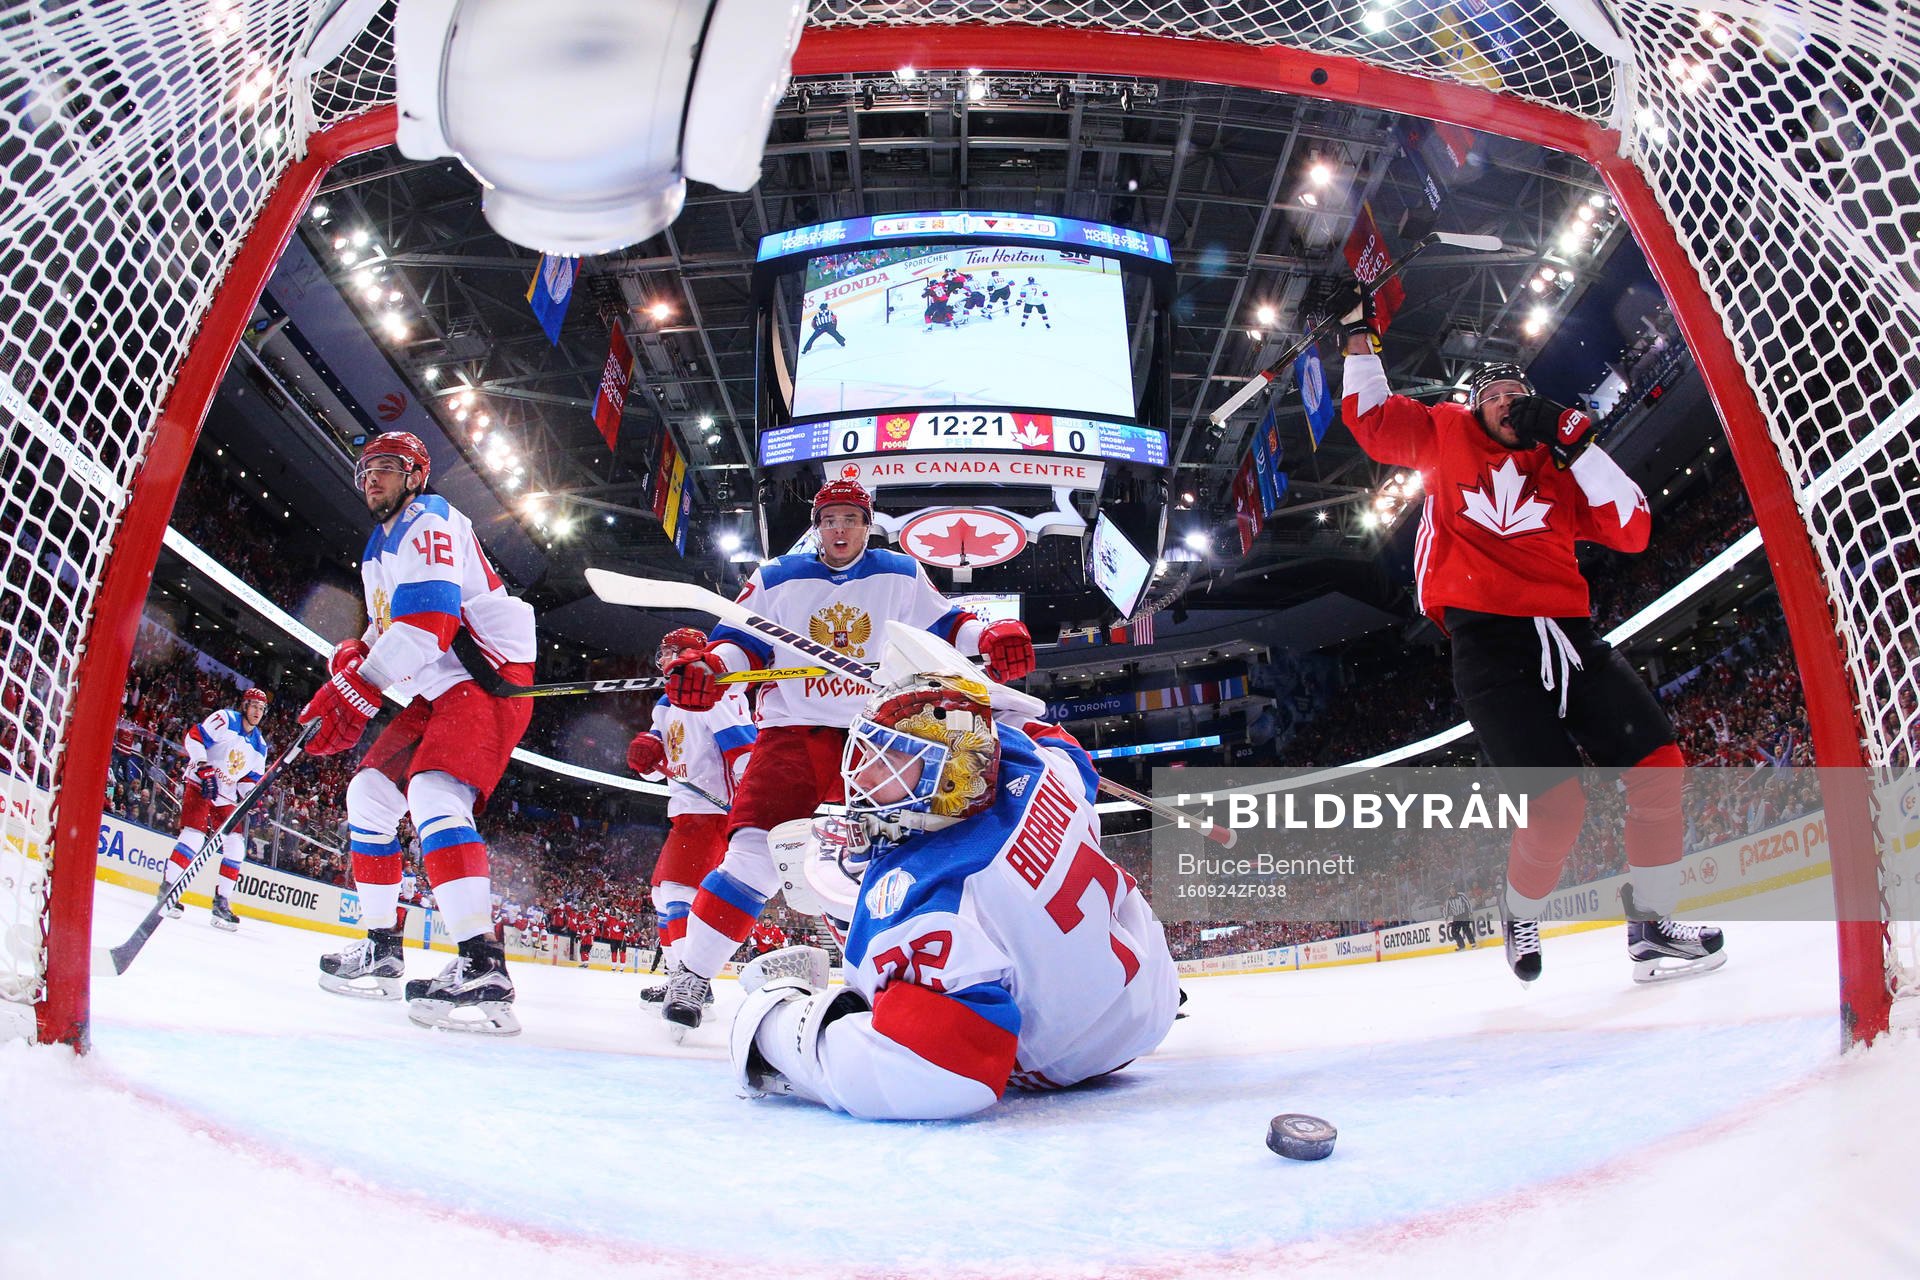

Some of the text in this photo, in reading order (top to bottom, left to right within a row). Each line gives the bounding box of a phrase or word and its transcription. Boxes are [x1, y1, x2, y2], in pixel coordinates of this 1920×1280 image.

[965, 245, 1046, 265] Tim Hortons
[824, 272, 890, 301] HONDA
[928, 415, 1003, 436] 12:21
[1088, 421, 1094, 429] 5
[842, 430, 859, 453] 0
[1069, 430, 1086, 452] 0
[872, 461, 1086, 478] AIR CANADA CENTRE
[411, 529, 454, 567] 42
[767, 668, 809, 678] TACKS
[1072, 700, 1121, 713] TORONTO
[1739, 829, 1799, 876] pizza
[233, 873, 319, 911] RIDGESTONE
[1335, 940, 1352, 956] VISA
[1383, 927, 1431, 949] GATORADE
